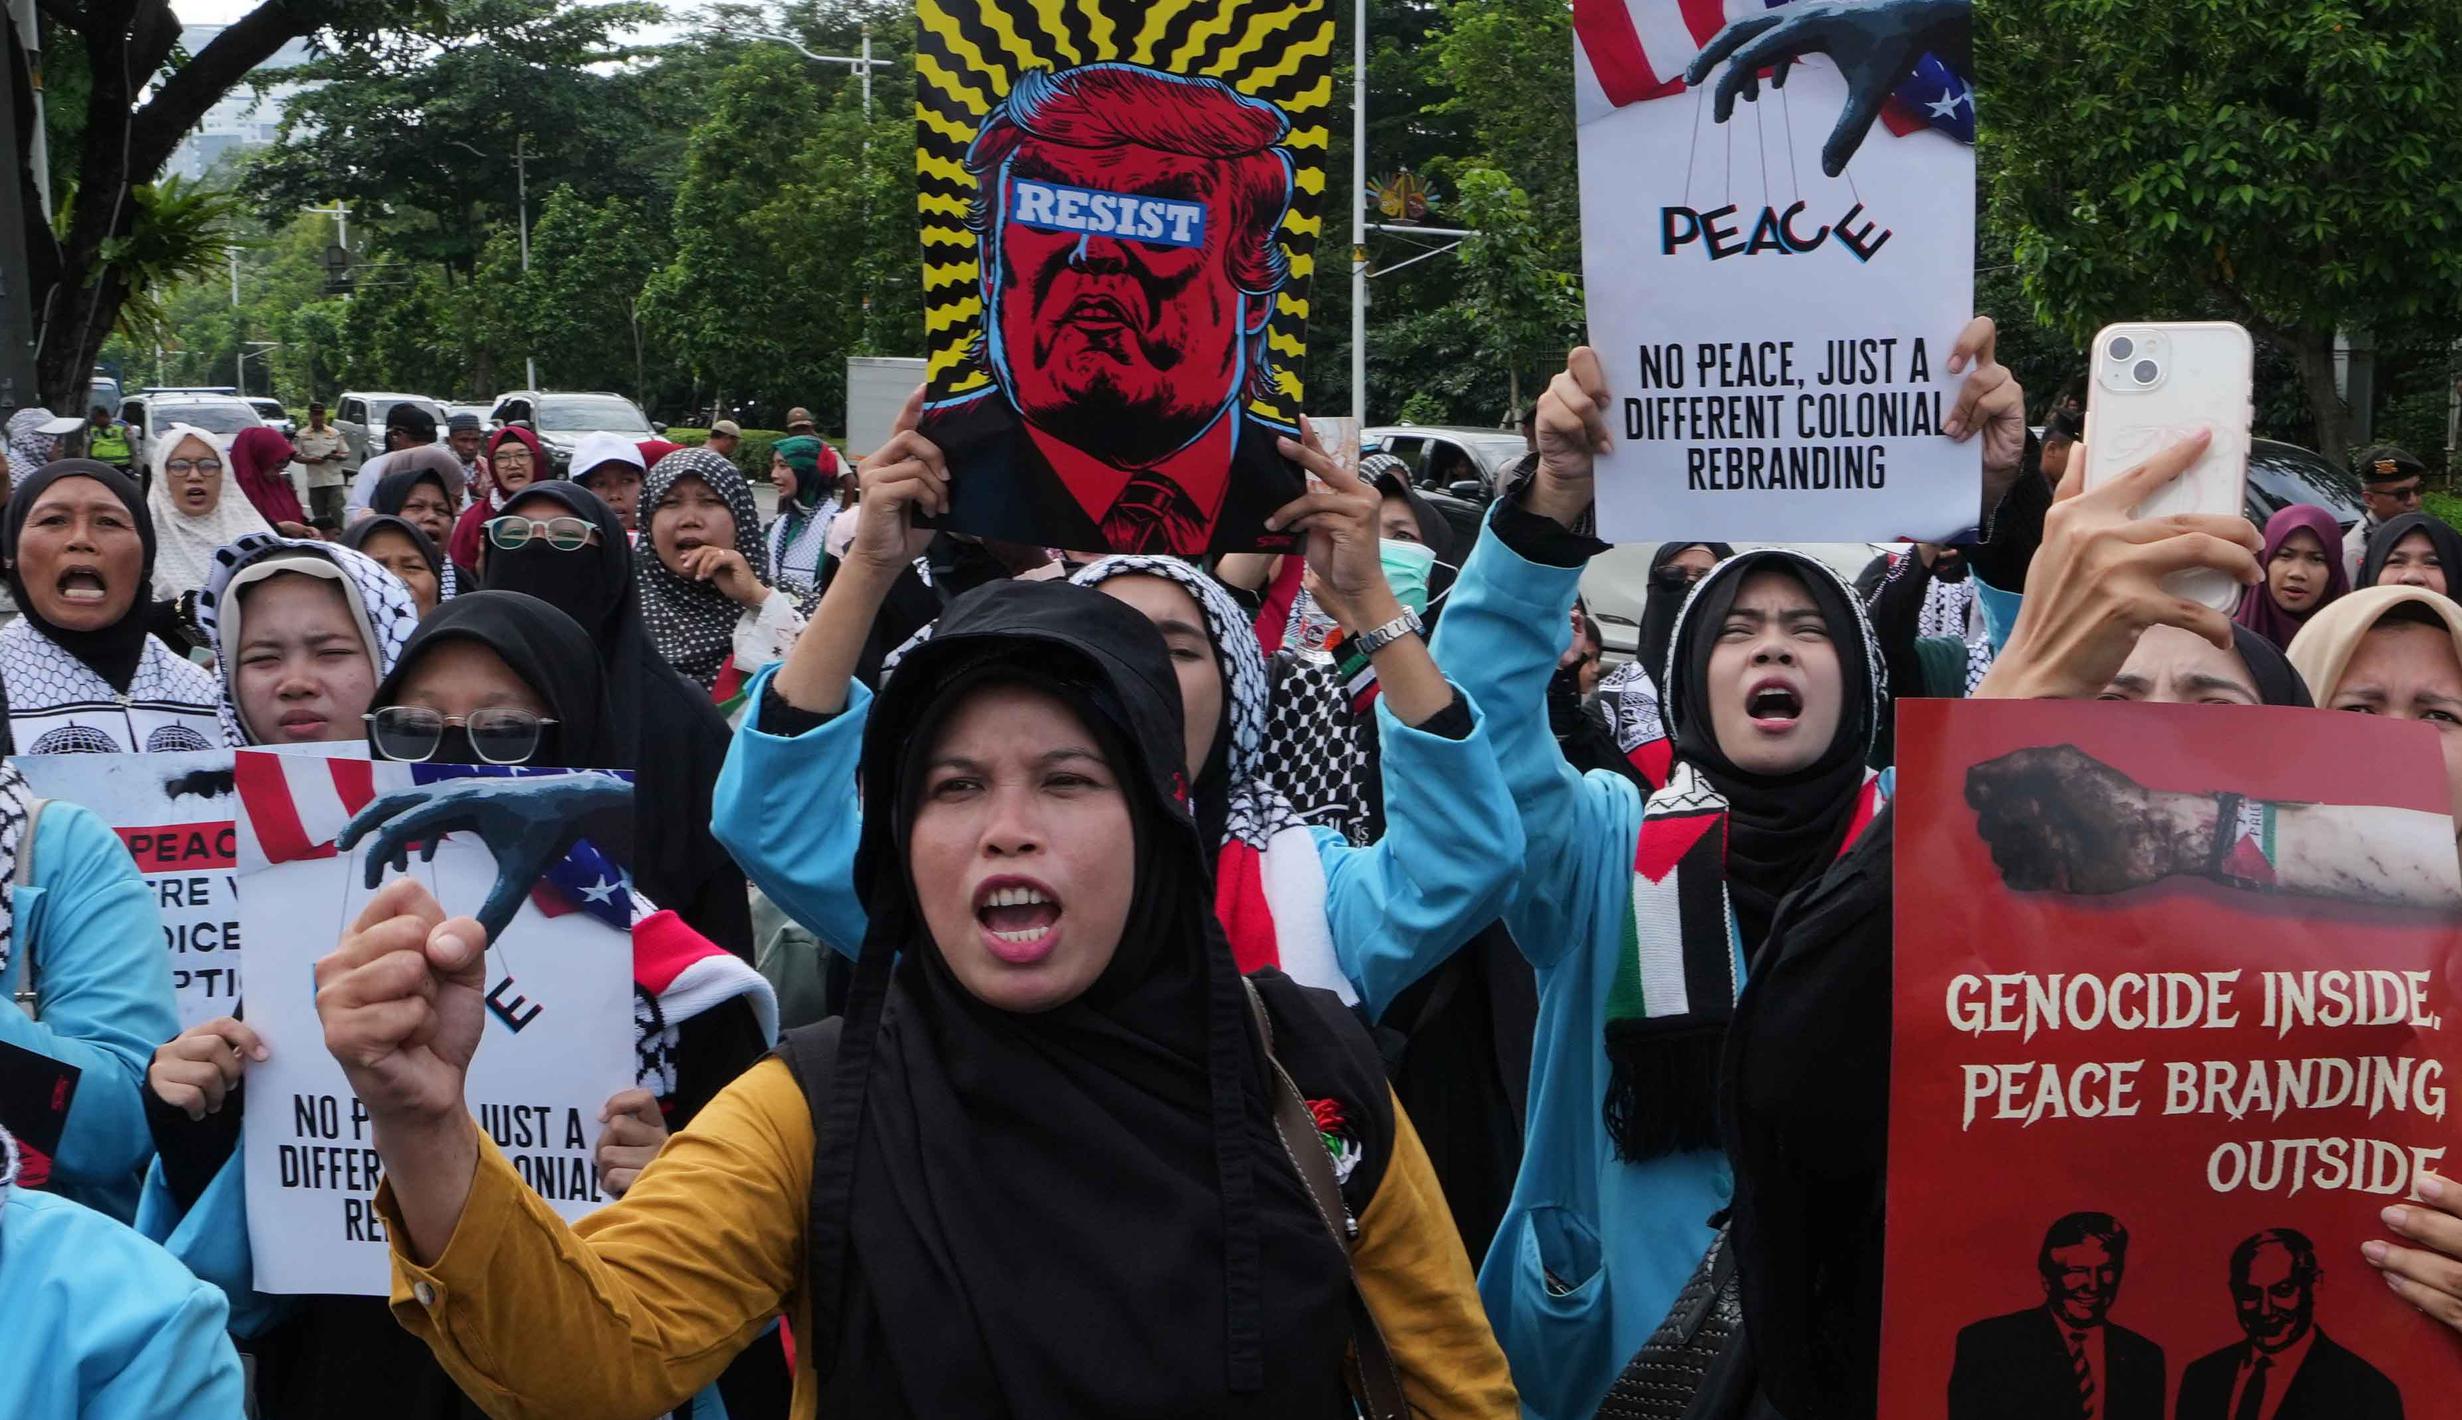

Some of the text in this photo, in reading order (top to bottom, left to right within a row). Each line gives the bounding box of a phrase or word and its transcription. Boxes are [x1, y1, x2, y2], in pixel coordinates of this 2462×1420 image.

[1016, 182, 1201, 242] RESIST
[1659, 199, 1893, 265] PEACE
[1639, 336, 1931, 391] NO PEACE, JUST A
[1623, 390, 1946, 441] DIFFERENT COLONIAL
[1686, 444, 1886, 491] REBRANDING
[128, 827, 237, 863] PEAC
[1945, 968, 2441, 1045] GENOCIDE INSIDE.
[293, 1093, 339, 1140] NO
[564, 1106, 587, 1150] A
[1959, 1055, 2447, 1132] PEACE BRANDING
[278, 1143, 603, 1203] DIFFER ONIAL
[2206, 1136, 2447, 1202] OUTSIDE
